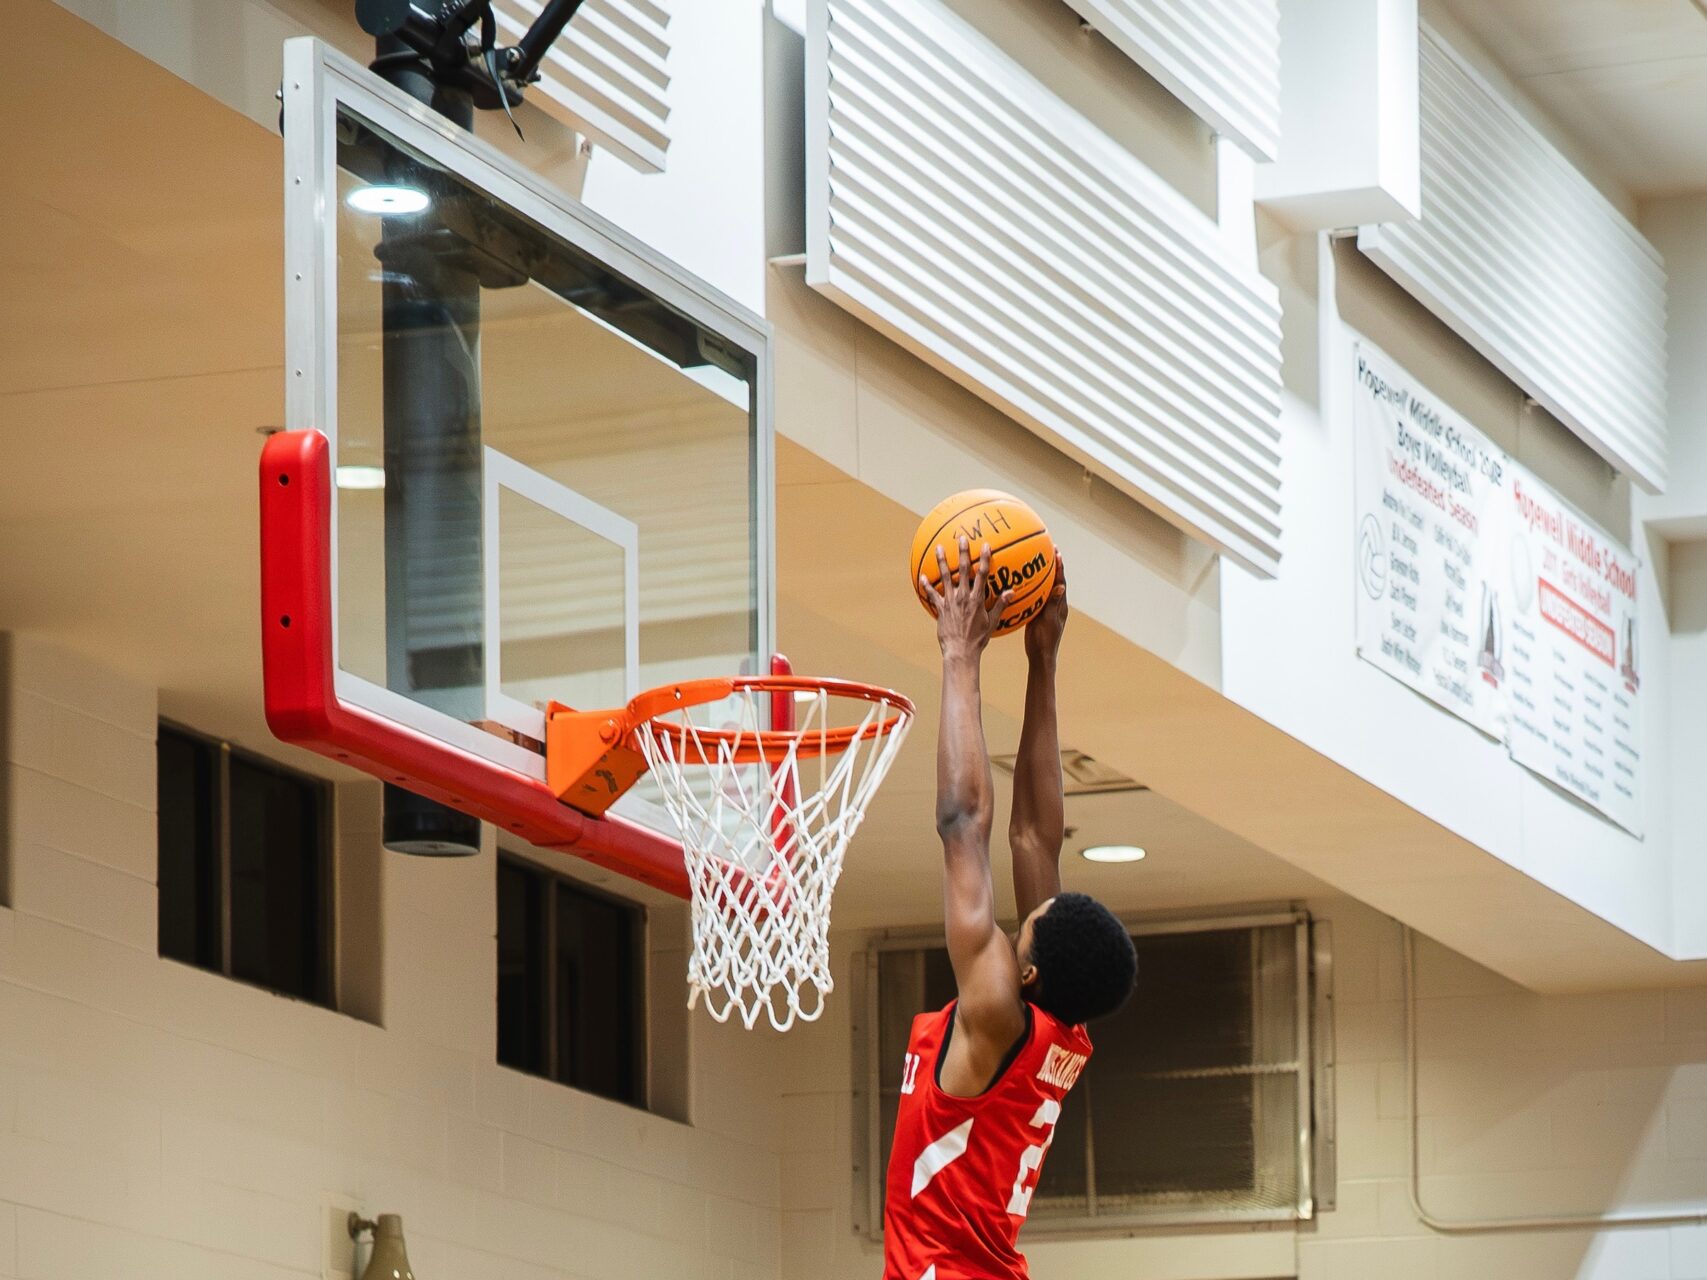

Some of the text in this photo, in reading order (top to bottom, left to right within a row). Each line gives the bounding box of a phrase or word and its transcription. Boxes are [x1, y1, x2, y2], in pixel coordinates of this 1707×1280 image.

[1357, 356, 1408, 413] Hopewell
[1409, 397, 1443, 441] Middle
[1444, 427, 1476, 468] School
[1397, 420, 1472, 497] Boys Volleyball
[972, 552, 1048, 600] ilson
[1514, 478, 1563, 546] Hopewell
[1603, 548, 1637, 603] School
